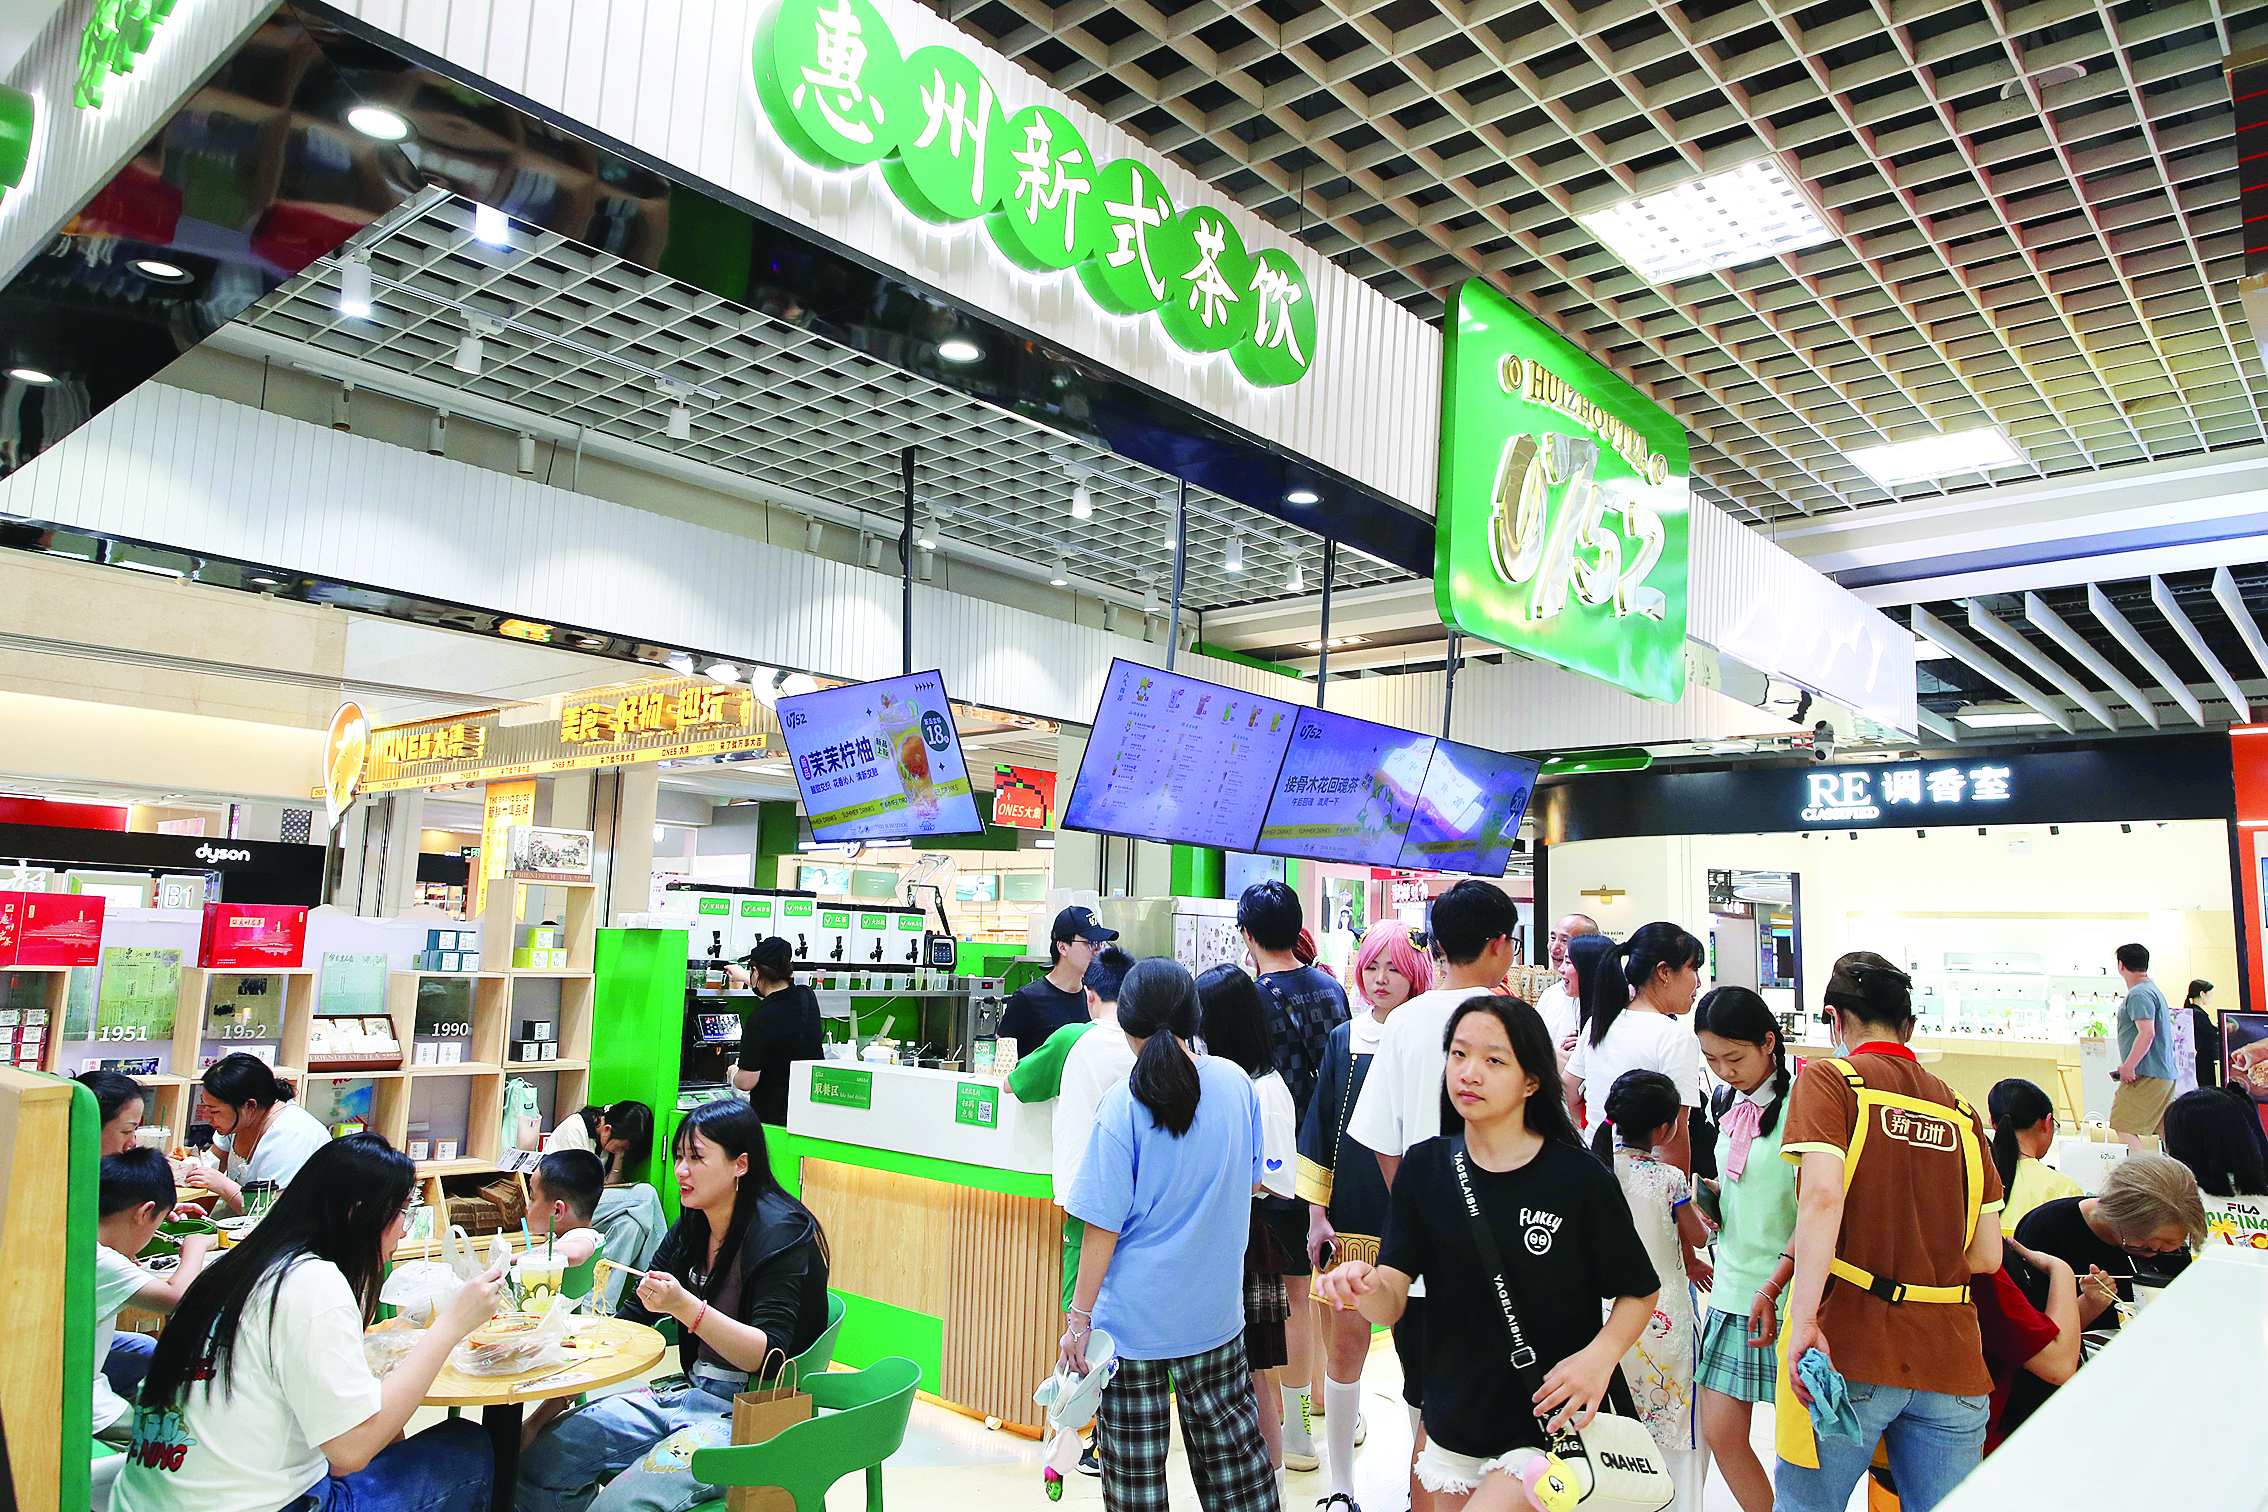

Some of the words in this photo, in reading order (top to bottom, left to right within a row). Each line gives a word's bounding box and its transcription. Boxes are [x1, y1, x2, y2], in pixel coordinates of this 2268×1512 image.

[791, 0, 1306, 367] 惠州新式茶饮
[786, 712, 807, 729] 0752
[1300, 725, 1322, 740] 0752
[1806, 771, 1872, 809] RE
[1880, 766, 2011, 805] 调香室
[997, 803, 1043, 820] ONES大集
[195, 842, 251, 864] dyson
[515, 870, 546, 880] FRIENDS
[164, 883, 196, 910] B1
[98, 1025, 148, 1042] 1951
[431, 1022, 470, 1037] 1990
[309, 1053, 347, 1061] FRIENDS
[814, 1082, 840, 1097] 取餐区
[2227, 1202, 2260, 1216] FILA
[1519, 1207, 1563, 1233] FLAKEY
